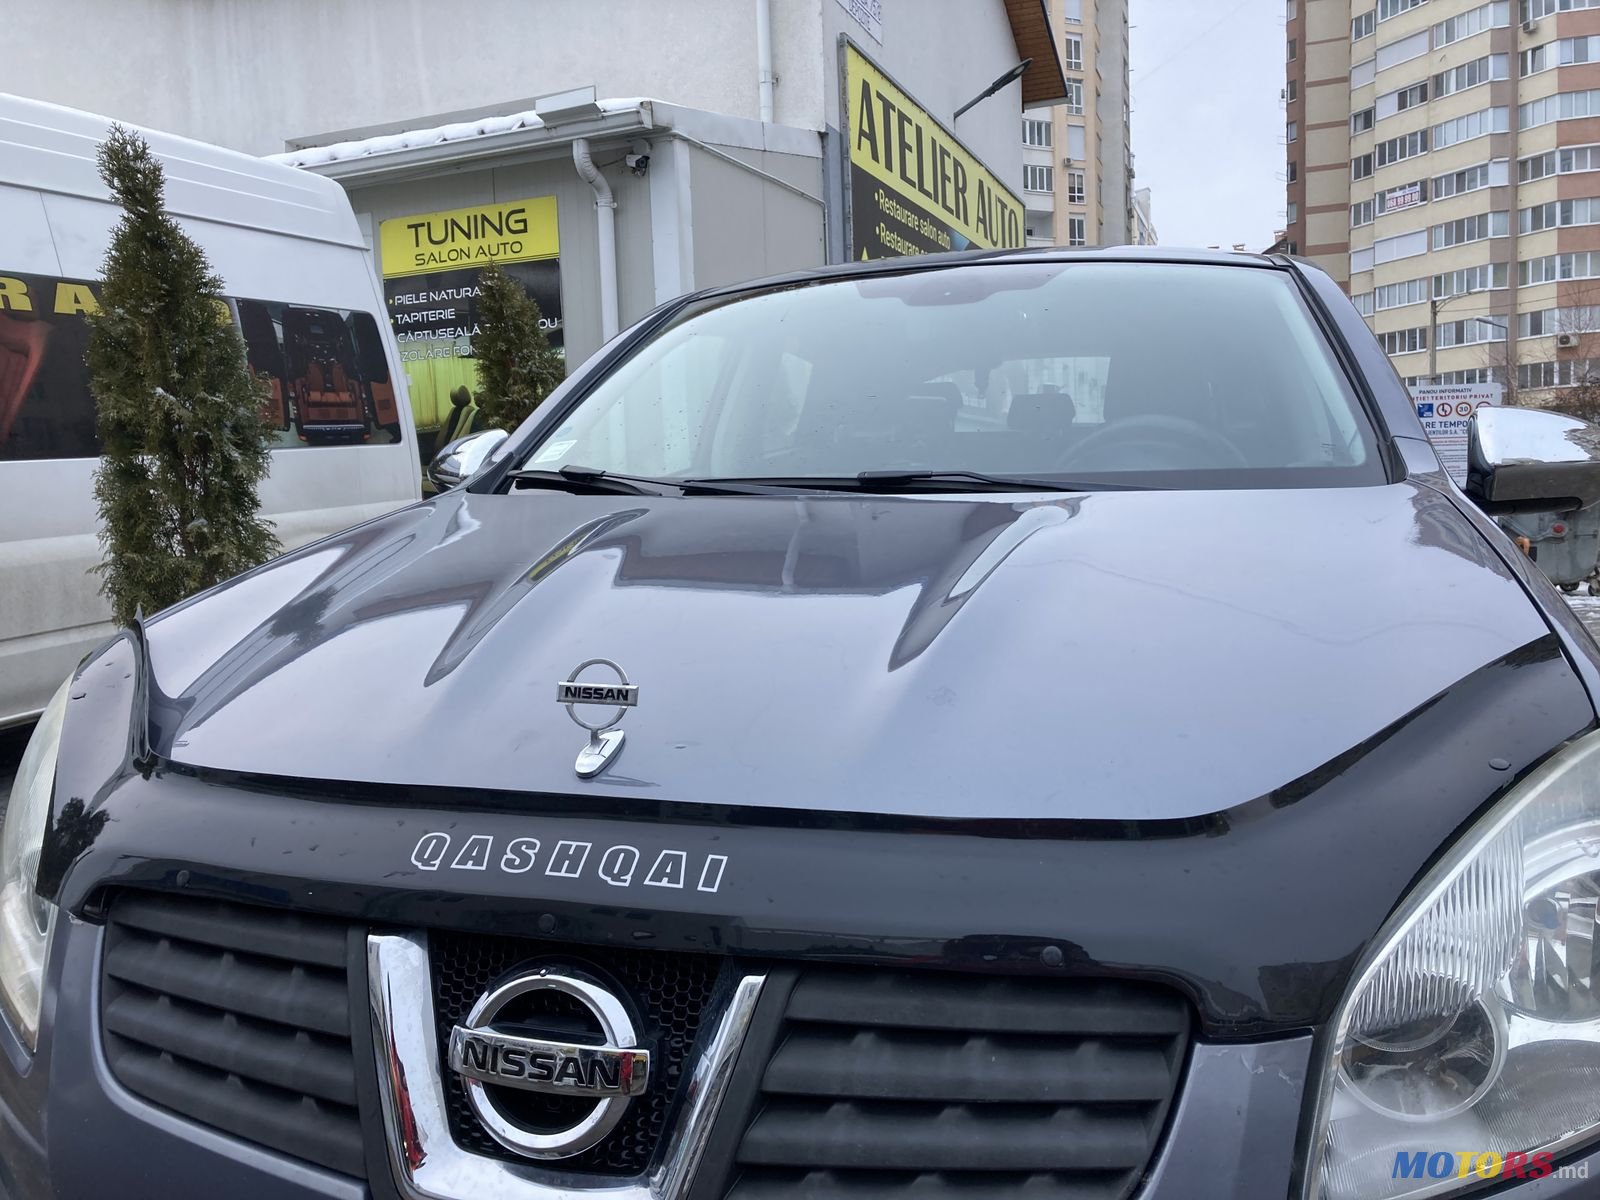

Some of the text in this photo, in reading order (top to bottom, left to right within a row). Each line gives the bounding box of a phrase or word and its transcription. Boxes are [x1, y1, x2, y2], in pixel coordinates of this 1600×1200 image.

[857, 78, 1019, 248] ATELIER AUTO
[407, 208, 528, 248] TUNING
[879, 189, 951, 250] Restaurare salon auto
[415, 241, 523, 266] SALON AUTO
[394, 286, 482, 306] PIELE NATURA
[401, 347, 450, 362] ZOLARE
[1439, 420, 1468, 428] TEMPO
[564, 686, 629, 701] NISSAN
[410, 832, 728, 892] QASHQAI
[462, 1040, 621, 1088] NISSAN
